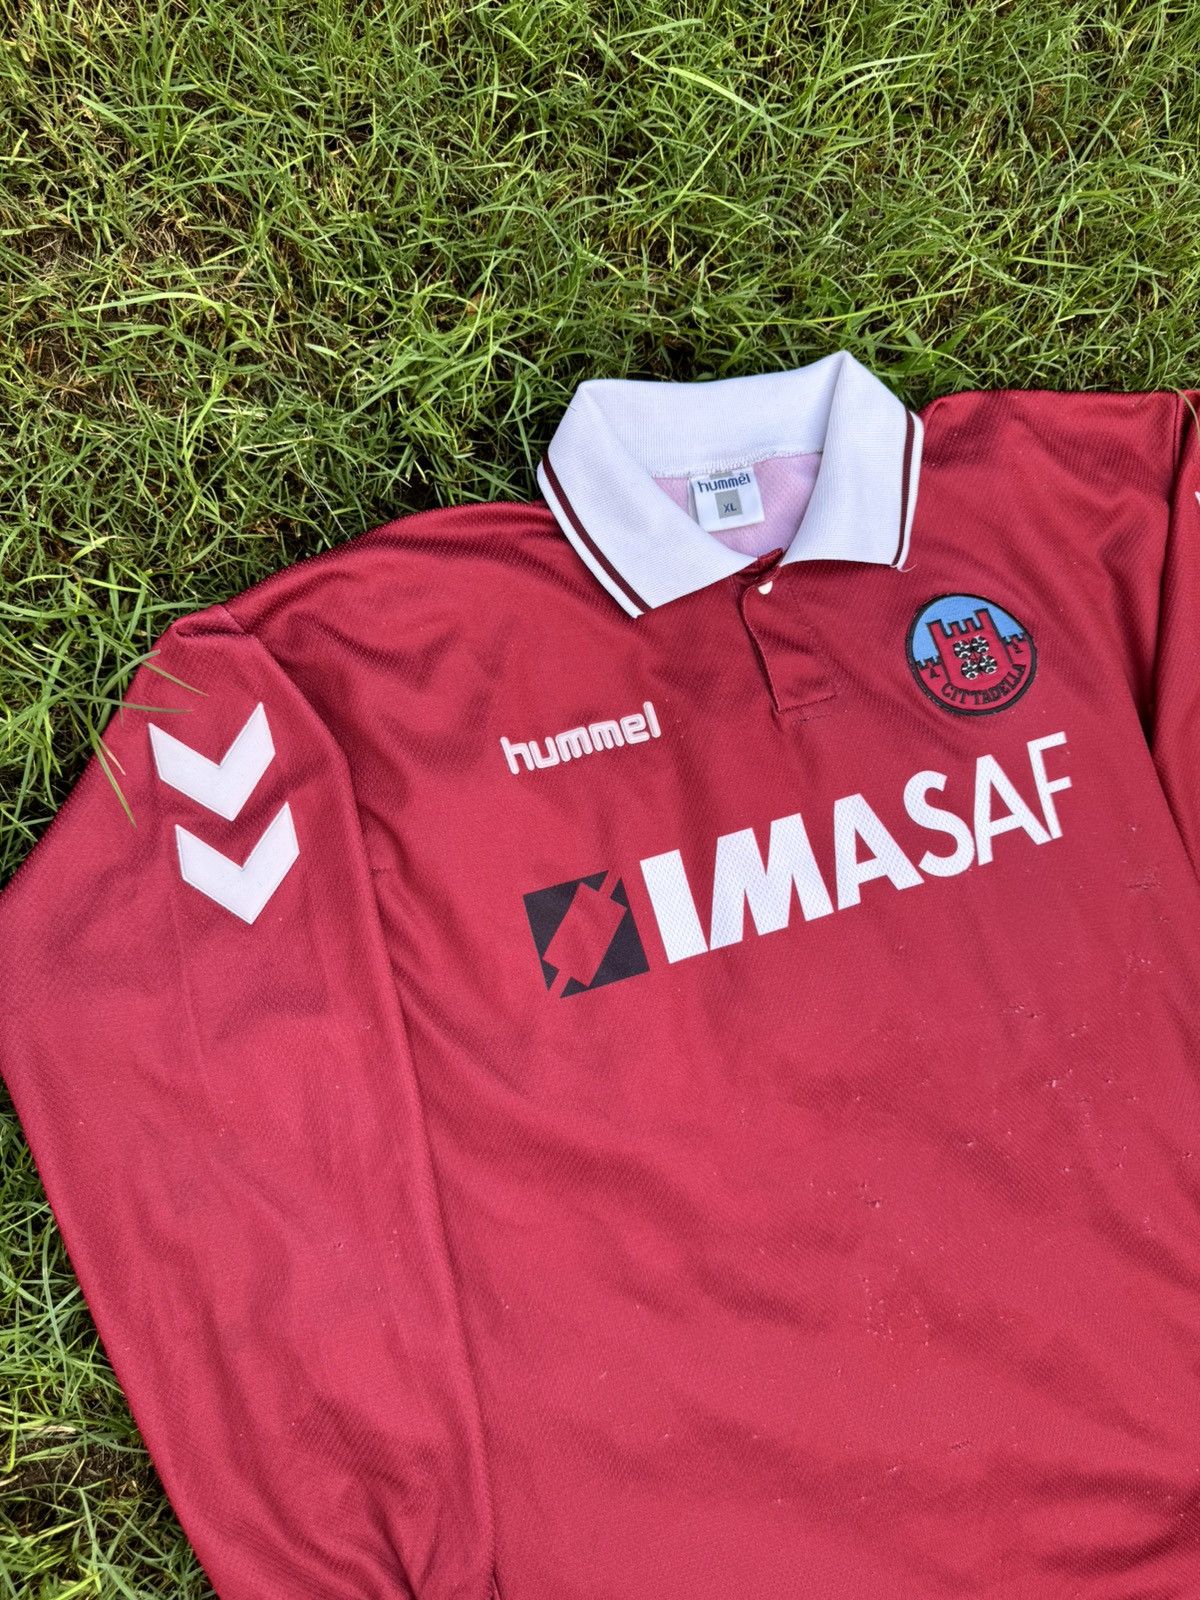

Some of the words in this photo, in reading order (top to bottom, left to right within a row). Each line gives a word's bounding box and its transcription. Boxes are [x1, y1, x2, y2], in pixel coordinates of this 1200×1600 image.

[697, 473, 751, 493] hummel
[723, 503, 737, 514] XL
[941, 663, 1027, 705] CITTADELLA
[500, 701, 662, 774] hummel
[639, 731, 1073, 964] IMASAF
